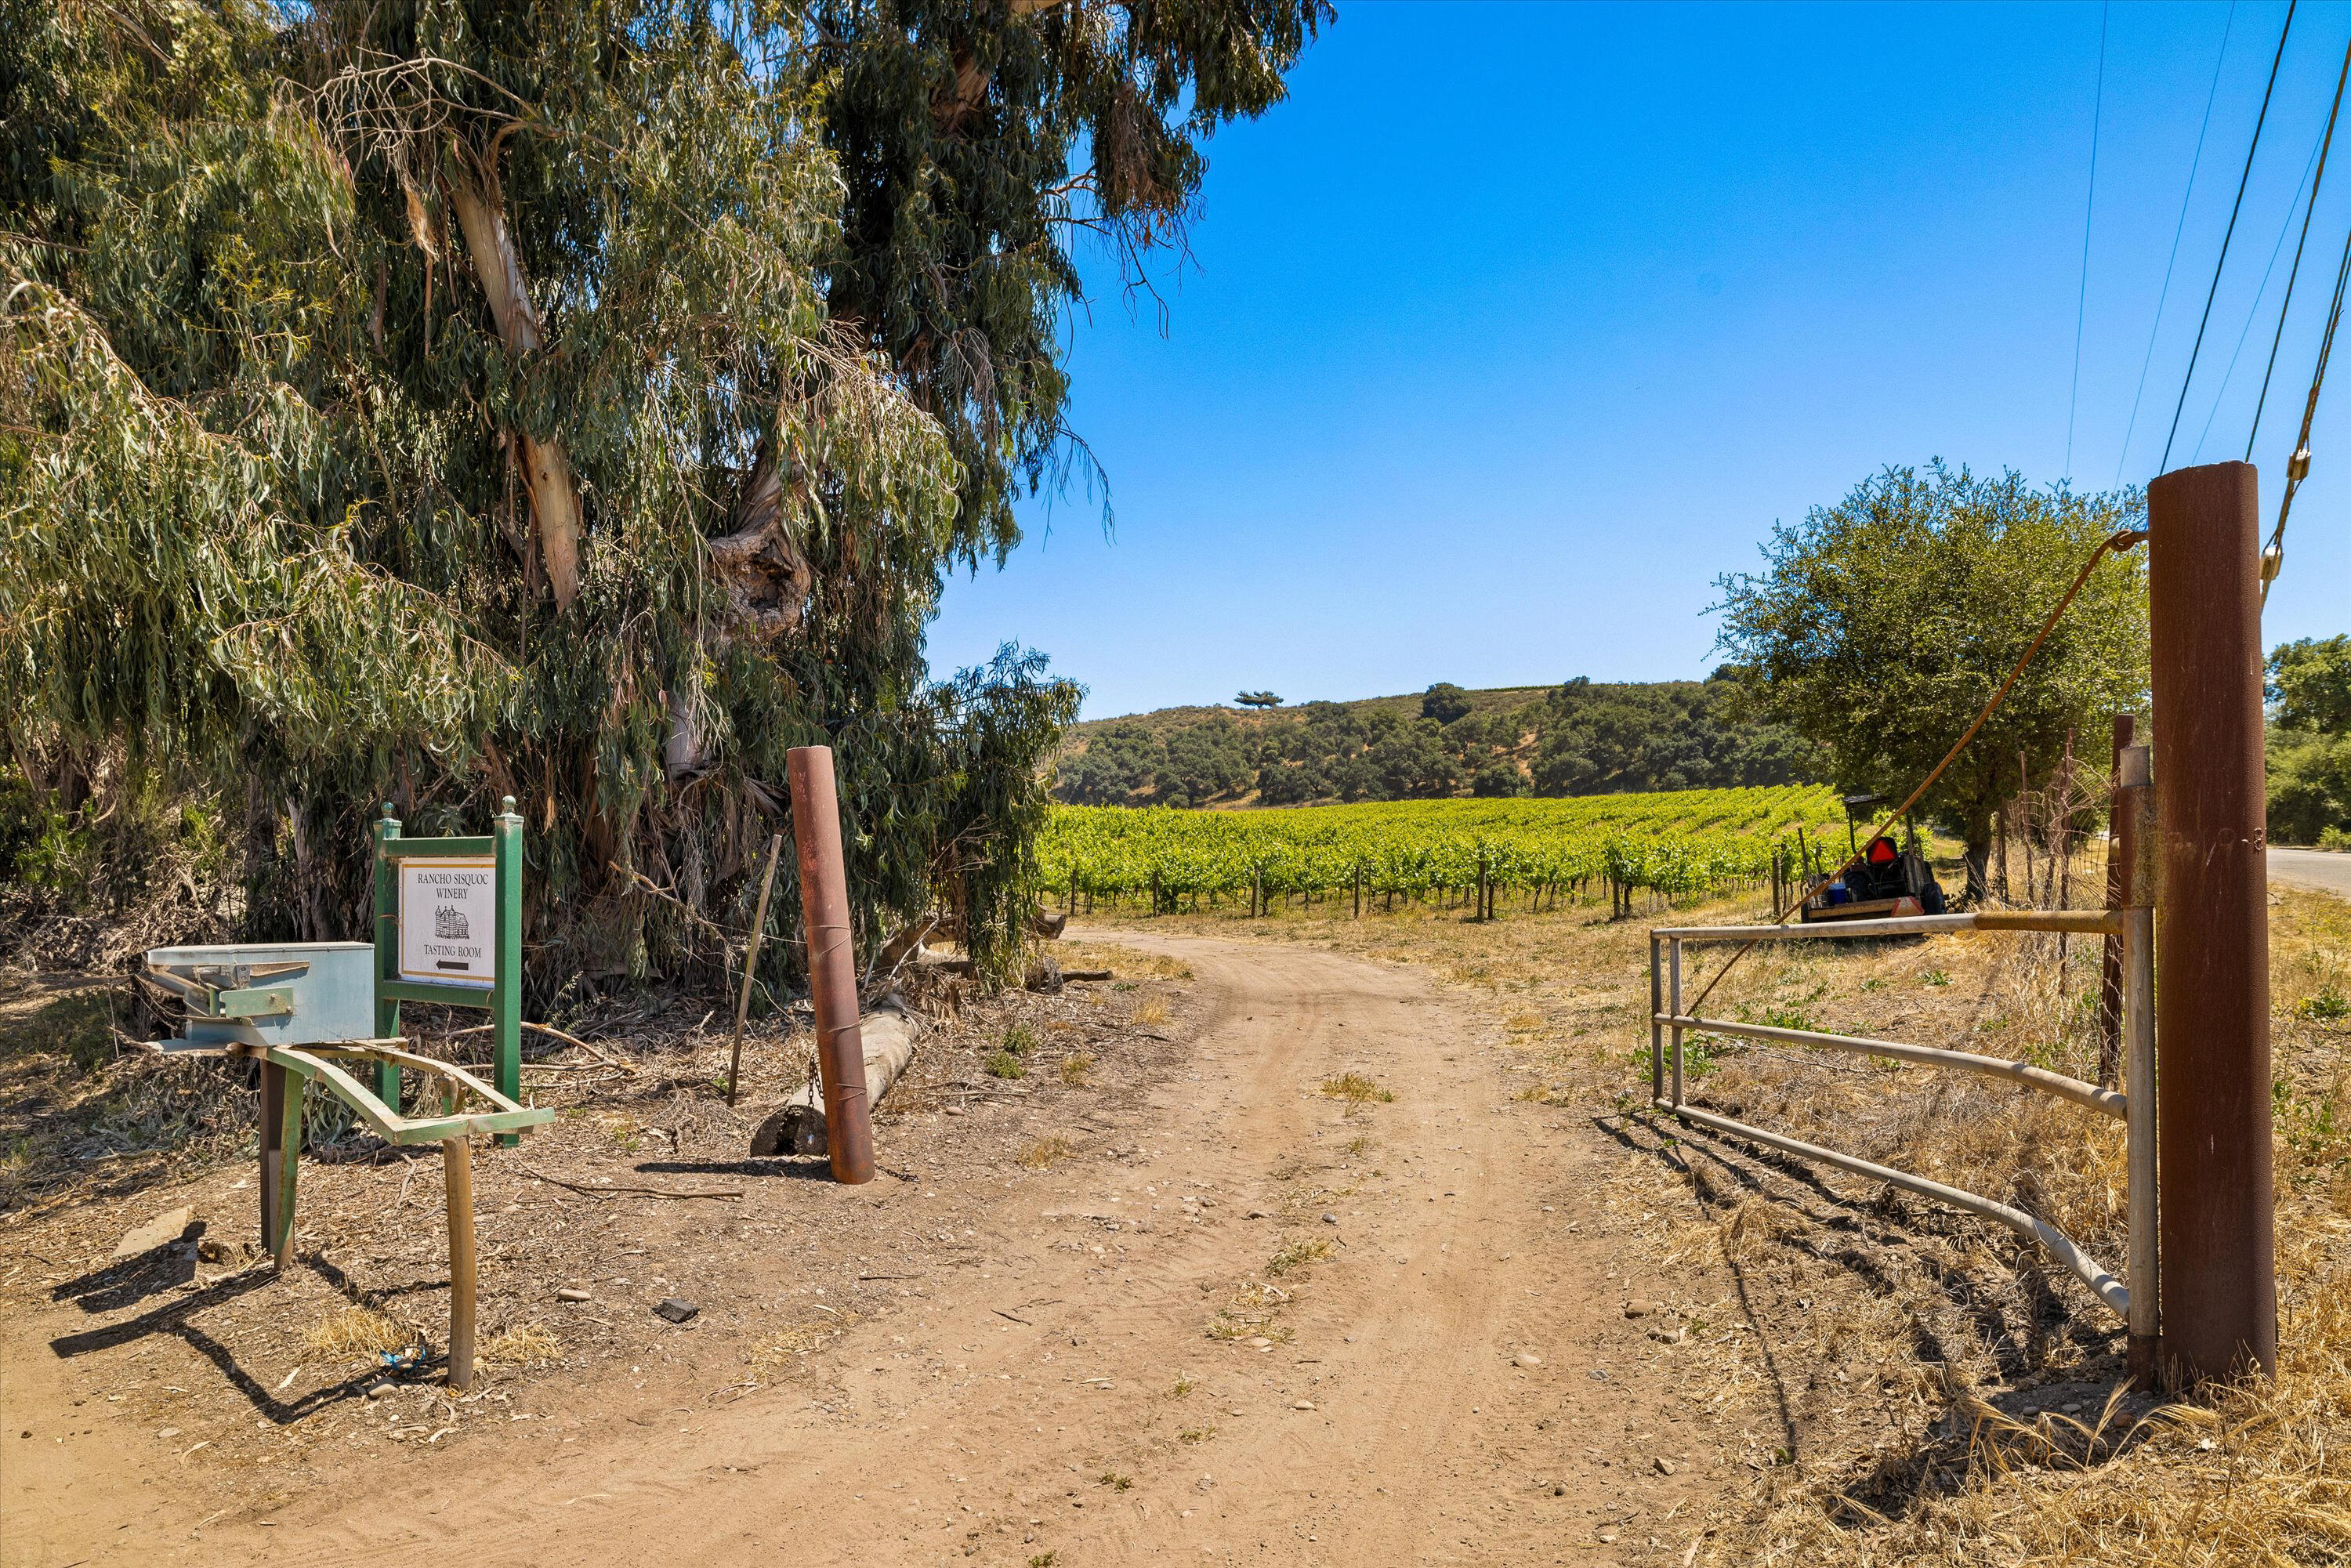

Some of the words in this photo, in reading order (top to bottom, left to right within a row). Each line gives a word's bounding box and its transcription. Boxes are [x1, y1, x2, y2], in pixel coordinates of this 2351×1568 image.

[418, 874, 451, 884] RANCHO
[455, 874, 488, 885] SISQUOC
[437, 889, 468, 899] WINERY
[424, 944, 455, 956] TASTING
[458, 948, 481, 958] ROOM
